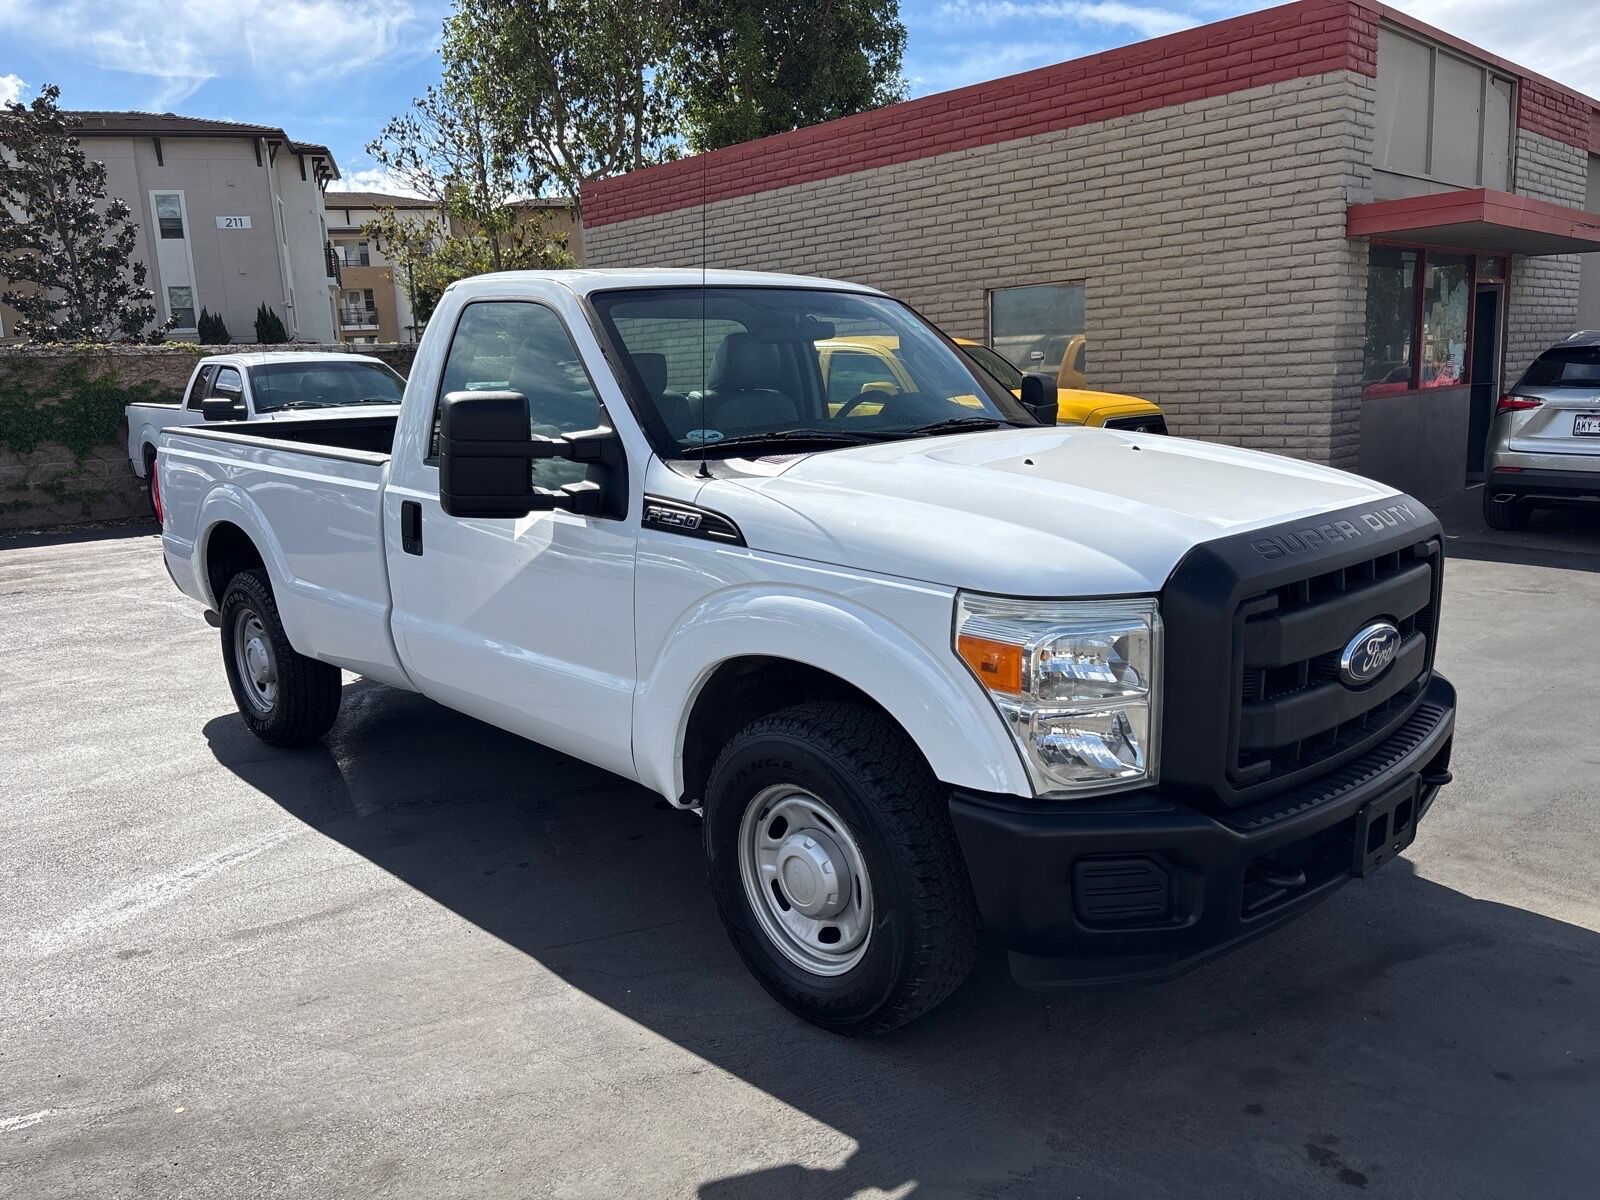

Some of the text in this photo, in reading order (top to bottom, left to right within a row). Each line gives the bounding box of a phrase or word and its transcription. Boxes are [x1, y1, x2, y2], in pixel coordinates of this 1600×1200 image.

[225, 217, 243, 228] 211
[1250, 503, 1416, 561] SUPER DUTY
[1362, 634, 1394, 672] Ford
